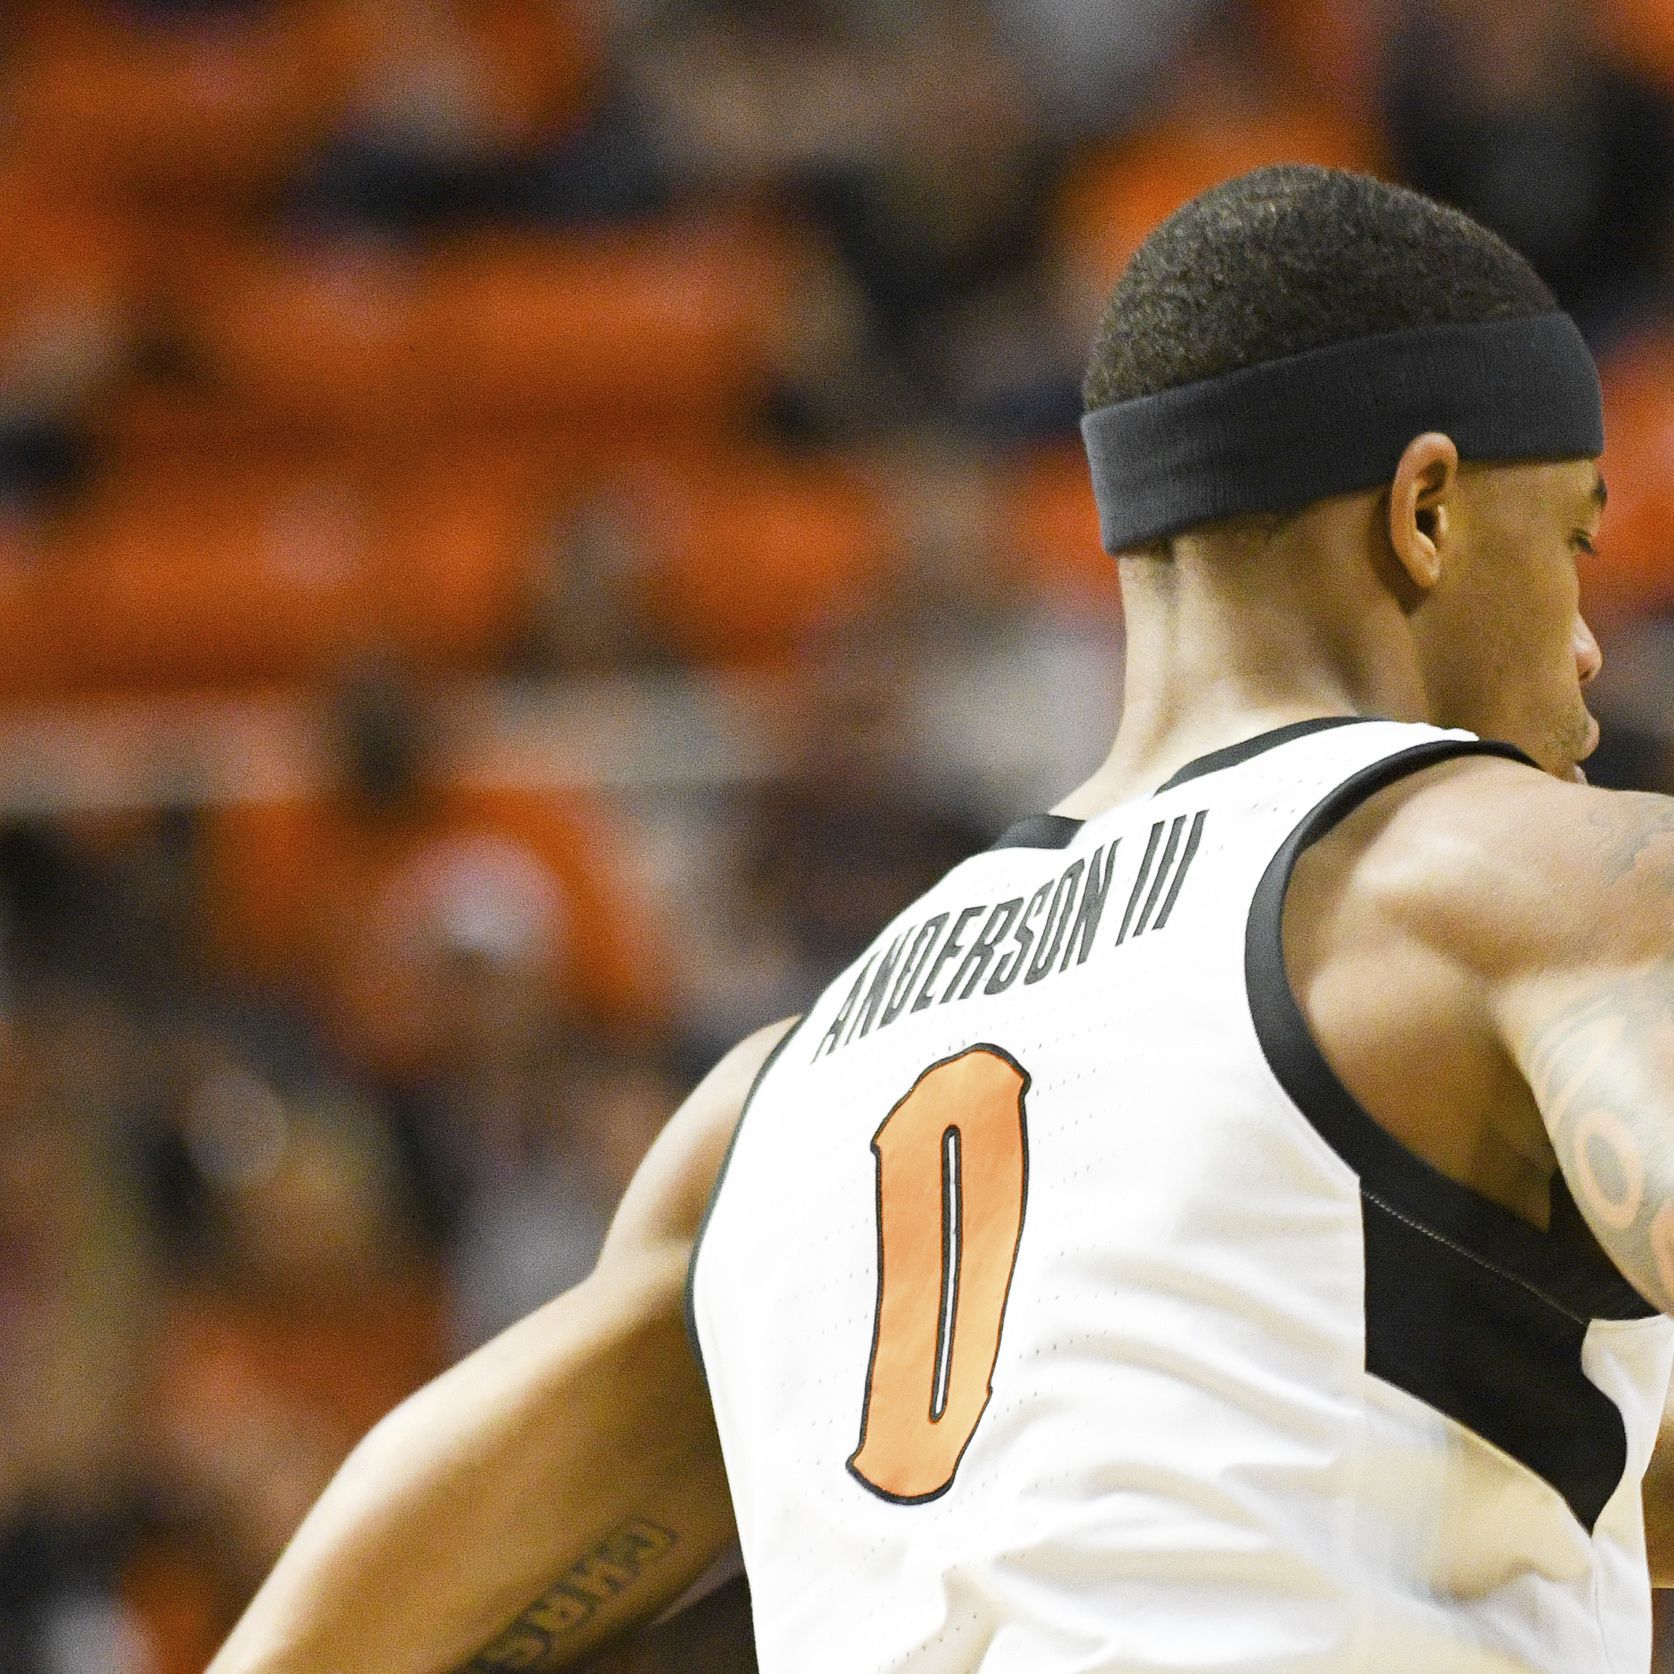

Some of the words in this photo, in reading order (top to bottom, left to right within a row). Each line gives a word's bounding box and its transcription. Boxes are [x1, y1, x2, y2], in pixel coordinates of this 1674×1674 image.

[810, 836, 1123, 1064] ANDERSON
[1114, 809, 1210, 947] III
[846, 1043, 1031, 1505] 0
